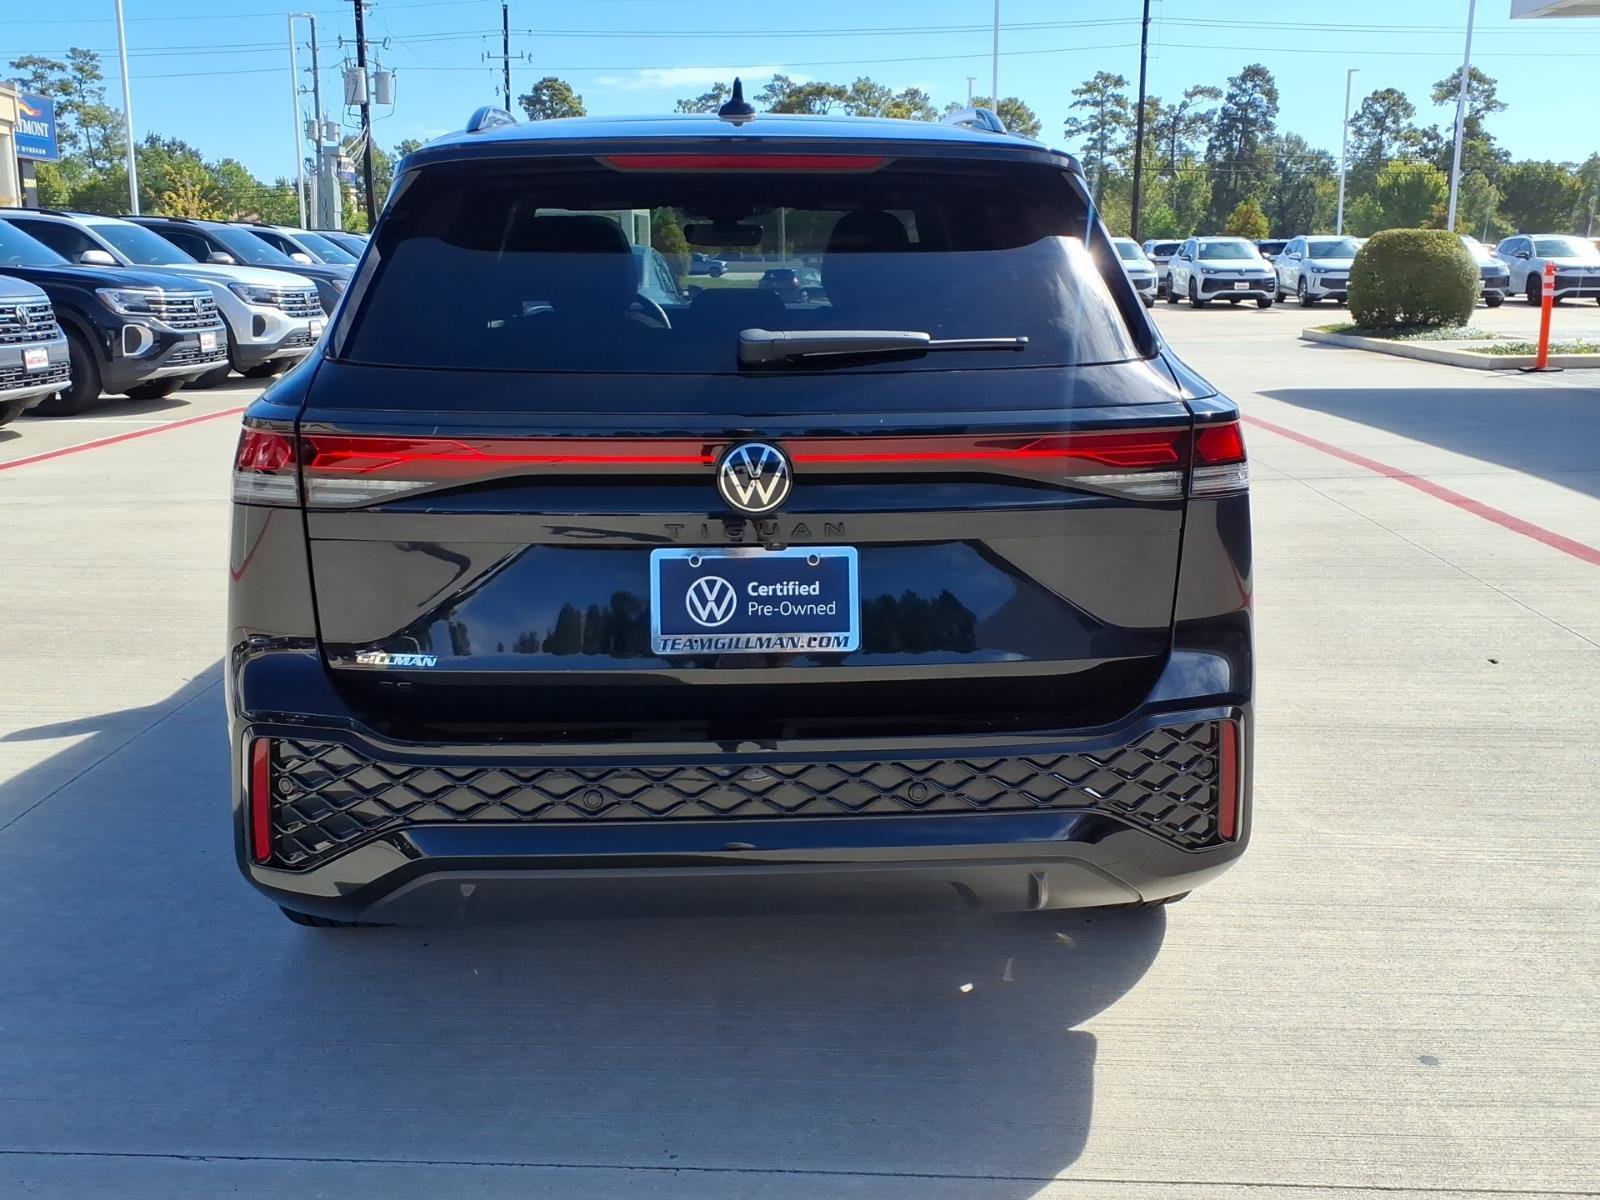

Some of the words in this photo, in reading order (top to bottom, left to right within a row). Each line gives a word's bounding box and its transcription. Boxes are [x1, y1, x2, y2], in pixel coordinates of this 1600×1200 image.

[720, 442, 790, 512] VW
[665, 522, 845, 538] TIGUAN
[747, 581, 820, 596] Certified
[686, 576, 737, 626] VW
[748, 600, 836, 616] Pre-Owned
[659, 635, 850, 651] TEAMGILLMAN.COM
[356, 651, 438, 667] GILLMAN
